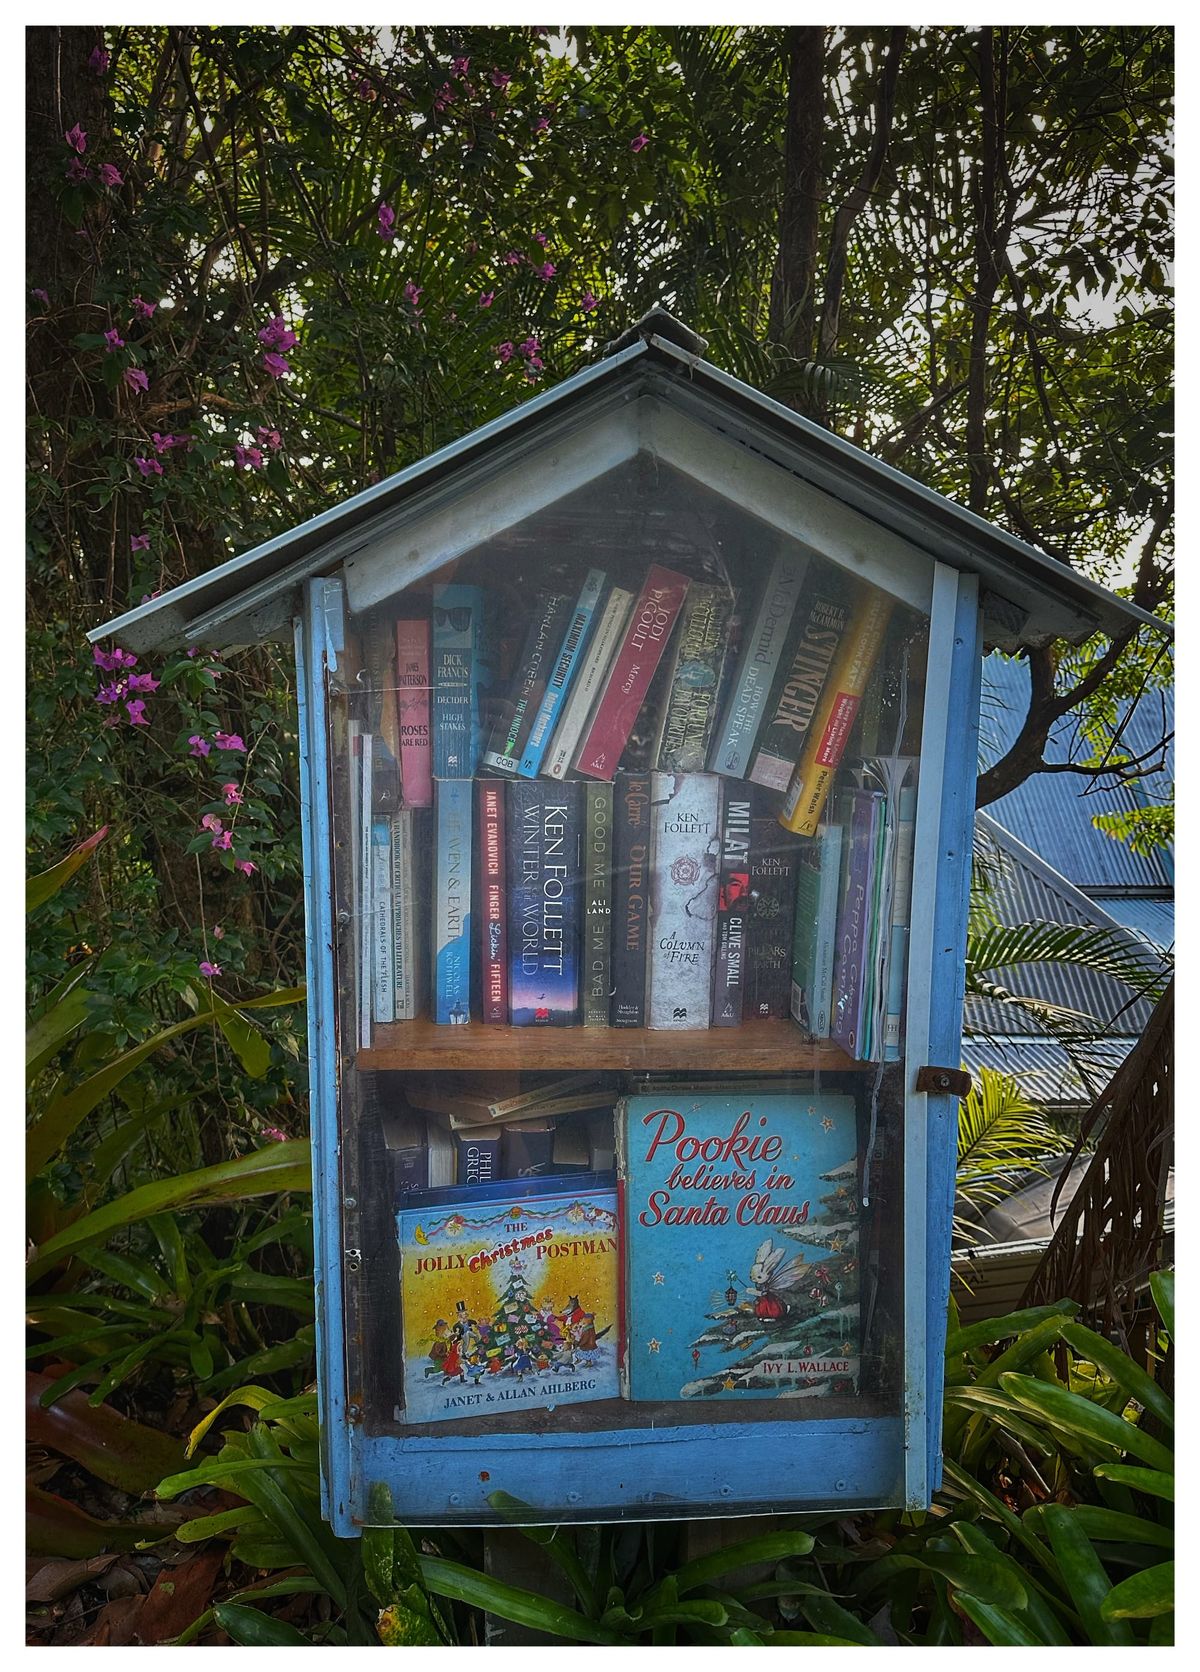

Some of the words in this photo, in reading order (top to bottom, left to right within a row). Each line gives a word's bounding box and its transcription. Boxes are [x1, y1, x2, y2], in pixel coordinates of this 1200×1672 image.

[631, 588, 663, 652] PICOULT
[648, 606, 670, 642] JODI
[753, 572, 796, 666] McDermid
[564, 612, 588, 656] MAXIMUM
[854, 630, 870, 659] LOOK
[437, 666, 469, 679] FRANCIS
[443, 653, 463, 666] DICK
[551, 652, 573, 690] SECURITY
[844, 657, 861, 689] FAT?
[400, 674, 427, 686] PATTERSON
[621, 664, 641, 695] Mercy
[739, 666, 759, 706] DEAD
[768, 623, 840, 733] STINGER
[437, 696, 469, 705] DECIDER
[515, 697, 528, 714] THE
[544, 692, 559, 713] Robert
[753, 685, 764, 709] HOW
[834, 696, 848, 720] Weight
[400, 725, 429, 736] ROSES
[439, 722, 466, 731] STAKES
[442, 713, 463, 722] HIGH
[504, 713, 523, 750] INNOCE
[726, 706, 747, 747] SPEAK
[743, 710, 754, 734] THE
[400, 738, 414, 747] ARE
[414, 738, 429, 747] RED
[825, 725, 837, 747] Living
[495, 756, 514, 769] COB
[820, 746, 831, 763] More
[629, 781, 648, 793] le
[814, 769, 828, 792] Peter
[486, 790, 497, 819] JANET
[624, 791, 649, 827] Carré
[806, 790, 821, 815] Walsh
[543, 804, 568, 857] KEN
[594, 796, 607, 854] GOOD
[663, 821, 710, 835] FOLLETT
[676, 812, 699, 823] KEN
[724, 801, 751, 861] MILAT
[487, 822, 498, 876] EVANOVICH
[521, 804, 540, 882] WINTER
[394, 860, 401, 868] OF
[593, 862, 606, 889] ME
[628, 844, 647, 889] OUR
[751, 865, 790, 877] FOLLETT
[762, 858, 781, 867] KEN
[448, 878, 460, 889] &
[489, 885, 500, 920] FINGER
[586, 907, 612, 915] LAND
[379, 901, 387, 945] CATHEDRALS
[395, 899, 403, 942] APPROACHES
[543, 864, 568, 976] FOLLETT
[625, 894, 644, 952] GAME
[850, 882, 864, 953] Peppa
[397, 942, 403, 950] TO
[488, 921, 502, 962] Lickin'
[521, 902, 540, 976] WORLD
[592, 925, 605, 952] ME
[659, 937, 705, 952] COLUMN
[669, 931, 676, 941] A
[728, 917, 743, 951] CLIVE
[380, 946, 387, 955] OF
[670, 951, 700, 965] FIRE
[747, 946, 787, 958] PILLARS
[753, 960, 781, 969] EARTH
[446, 950, 454, 1000] ROTHWELL
[452, 953, 460, 994] NICOLAS
[491, 963, 502, 1004] FIFTEEN
[591, 960, 605, 998] BAD
[726, 952, 742, 988] SMALL
[837, 934, 851, 1034] Campng
[641, 1108, 783, 1172] Pookie
[664, 1162, 757, 1191] believes
[761, 1164, 796, 1191] in
[638, 1190, 731, 1228] Santa
[735, 1192, 811, 1228] Claus
[504, 1221, 528, 1233] THE
[414, 1253, 468, 1275] JOLLY
[468, 1226, 554, 1274] Christmas
[535, 1238, 618, 1260] POSTMAN
[763, 1362, 783, 1374] IVY
[787, 1362, 798, 1374] L.
[799, 1361, 850, 1373] WALLACE
[443, 1394, 483, 1409] JANET
[485, 1393, 495, 1402] &
[497, 1386, 537, 1401] ALLAN
[540, 1379, 597, 1395] AHLBERG
